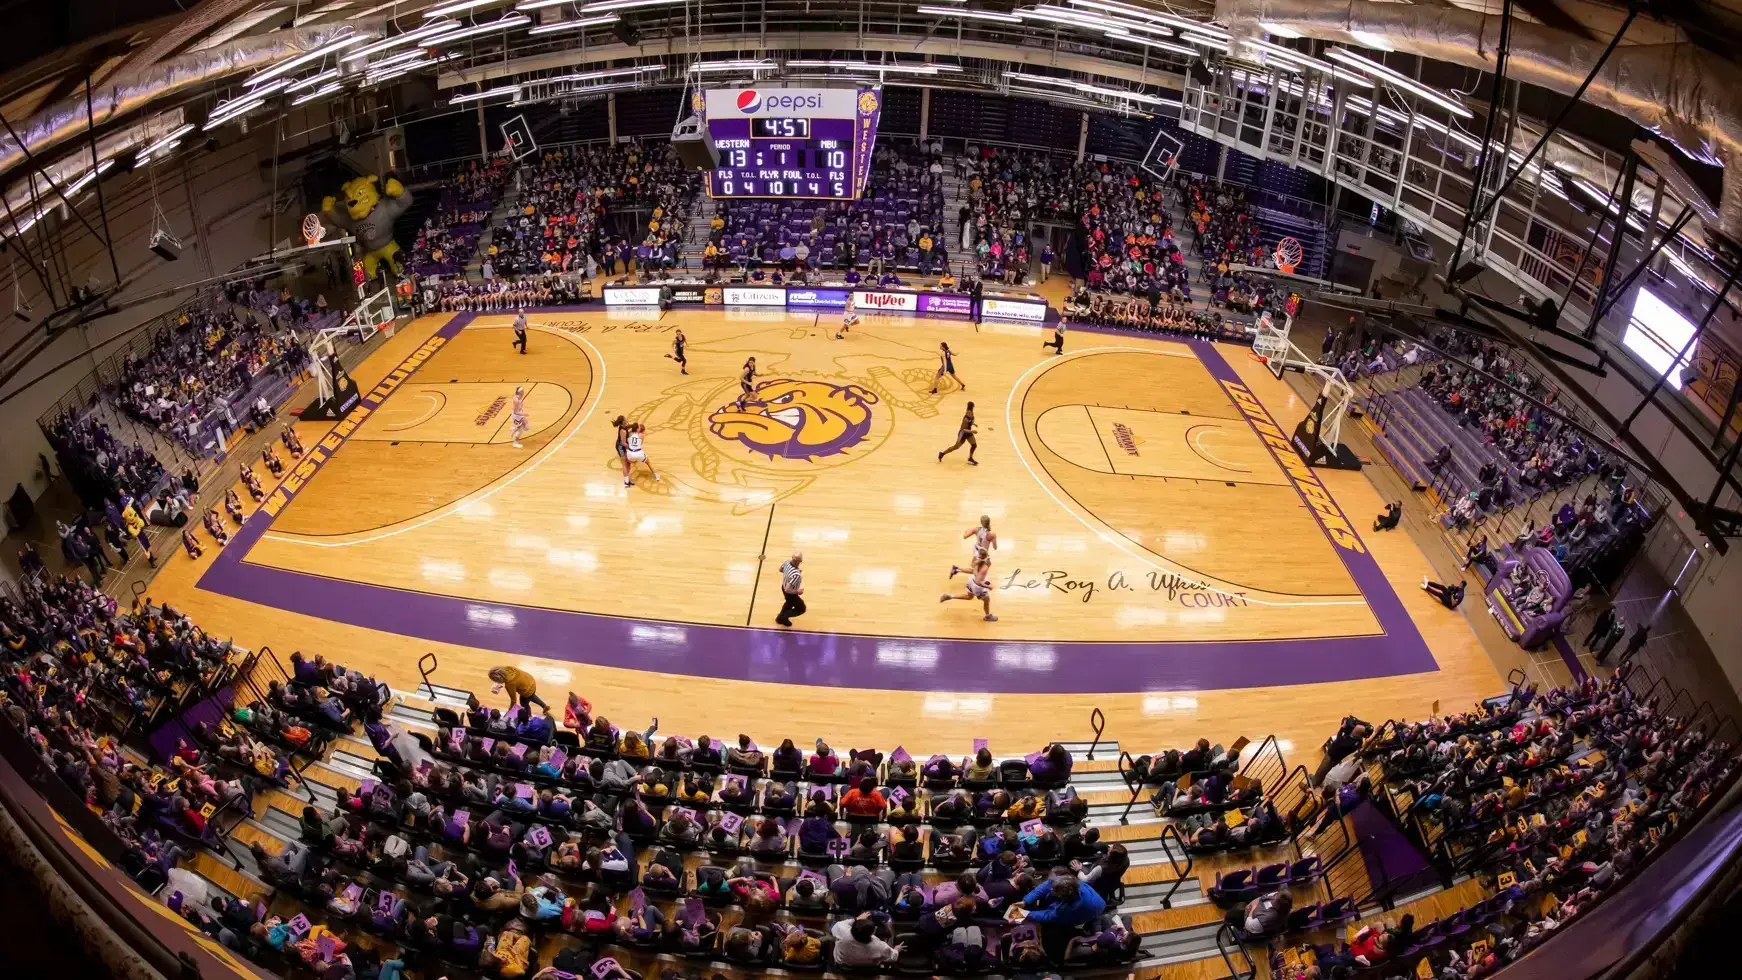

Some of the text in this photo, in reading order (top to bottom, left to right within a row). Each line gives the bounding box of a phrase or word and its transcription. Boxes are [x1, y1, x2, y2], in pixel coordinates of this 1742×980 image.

[766, 93, 822, 111] pepsi
[765, 119, 808, 137] 4:57
[715, 139, 750, 149] WESTERN
[820, 140, 837, 149] MBU
[730, 150, 746, 167] 13
[781, 152, 785, 165] 1
[827, 151, 845, 168] 10
[856, 118, 872, 199] WESTERN
[718, 170, 733, 179] FLS
[759, 170, 803, 179] PLYR FOUL
[829, 171, 845, 181] FLS
[723, 181, 733, 195] 0
[743, 181, 754, 194] 4
[769, 181, 784, 195] 10
[808, 181, 819, 195] 4
[833, 182, 844, 197] 5
[743, 291, 779, 300] Citizens
[366, 335, 447, 405] ILLINOIS
[261, 404, 371, 517] WESTERN
[1179, 591, 1250, 609] COURT
[723, 814, 739, 830] 3
[535, 829, 546, 845] 3
